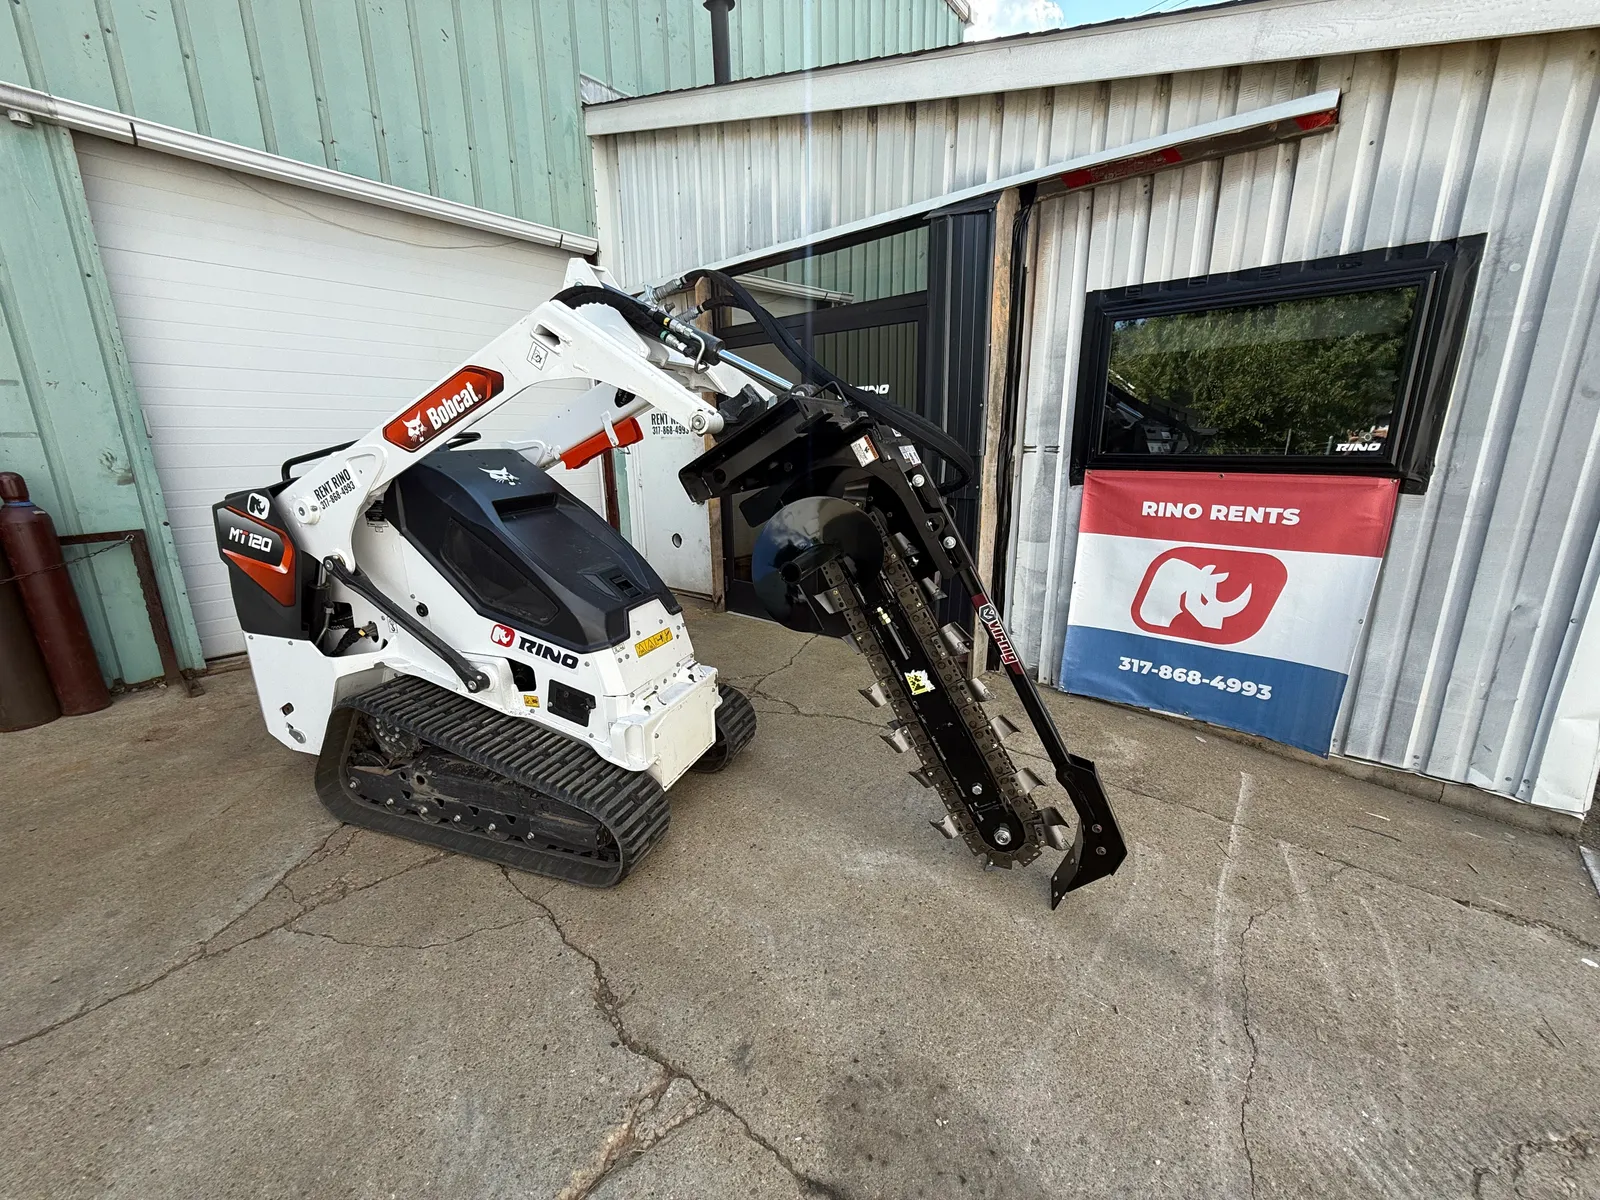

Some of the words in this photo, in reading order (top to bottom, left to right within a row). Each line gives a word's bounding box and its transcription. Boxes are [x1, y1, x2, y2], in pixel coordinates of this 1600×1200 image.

[426, 381, 480, 431] Bobcat
[651, 413, 668, 425] RENT
[1335, 443, 1382, 452] RINO
[313, 480, 333, 501] RENT
[330, 468, 351, 489] RINO
[320, 480, 356, 510] 317-868-4993
[1141, 501, 1203, 520] RINO
[1209, 504, 1301, 526] RENTS
[228, 526, 273, 553] MT120
[518, 635, 580, 670] RINO
[1118, 656, 1273, 701] 317-868-4993
